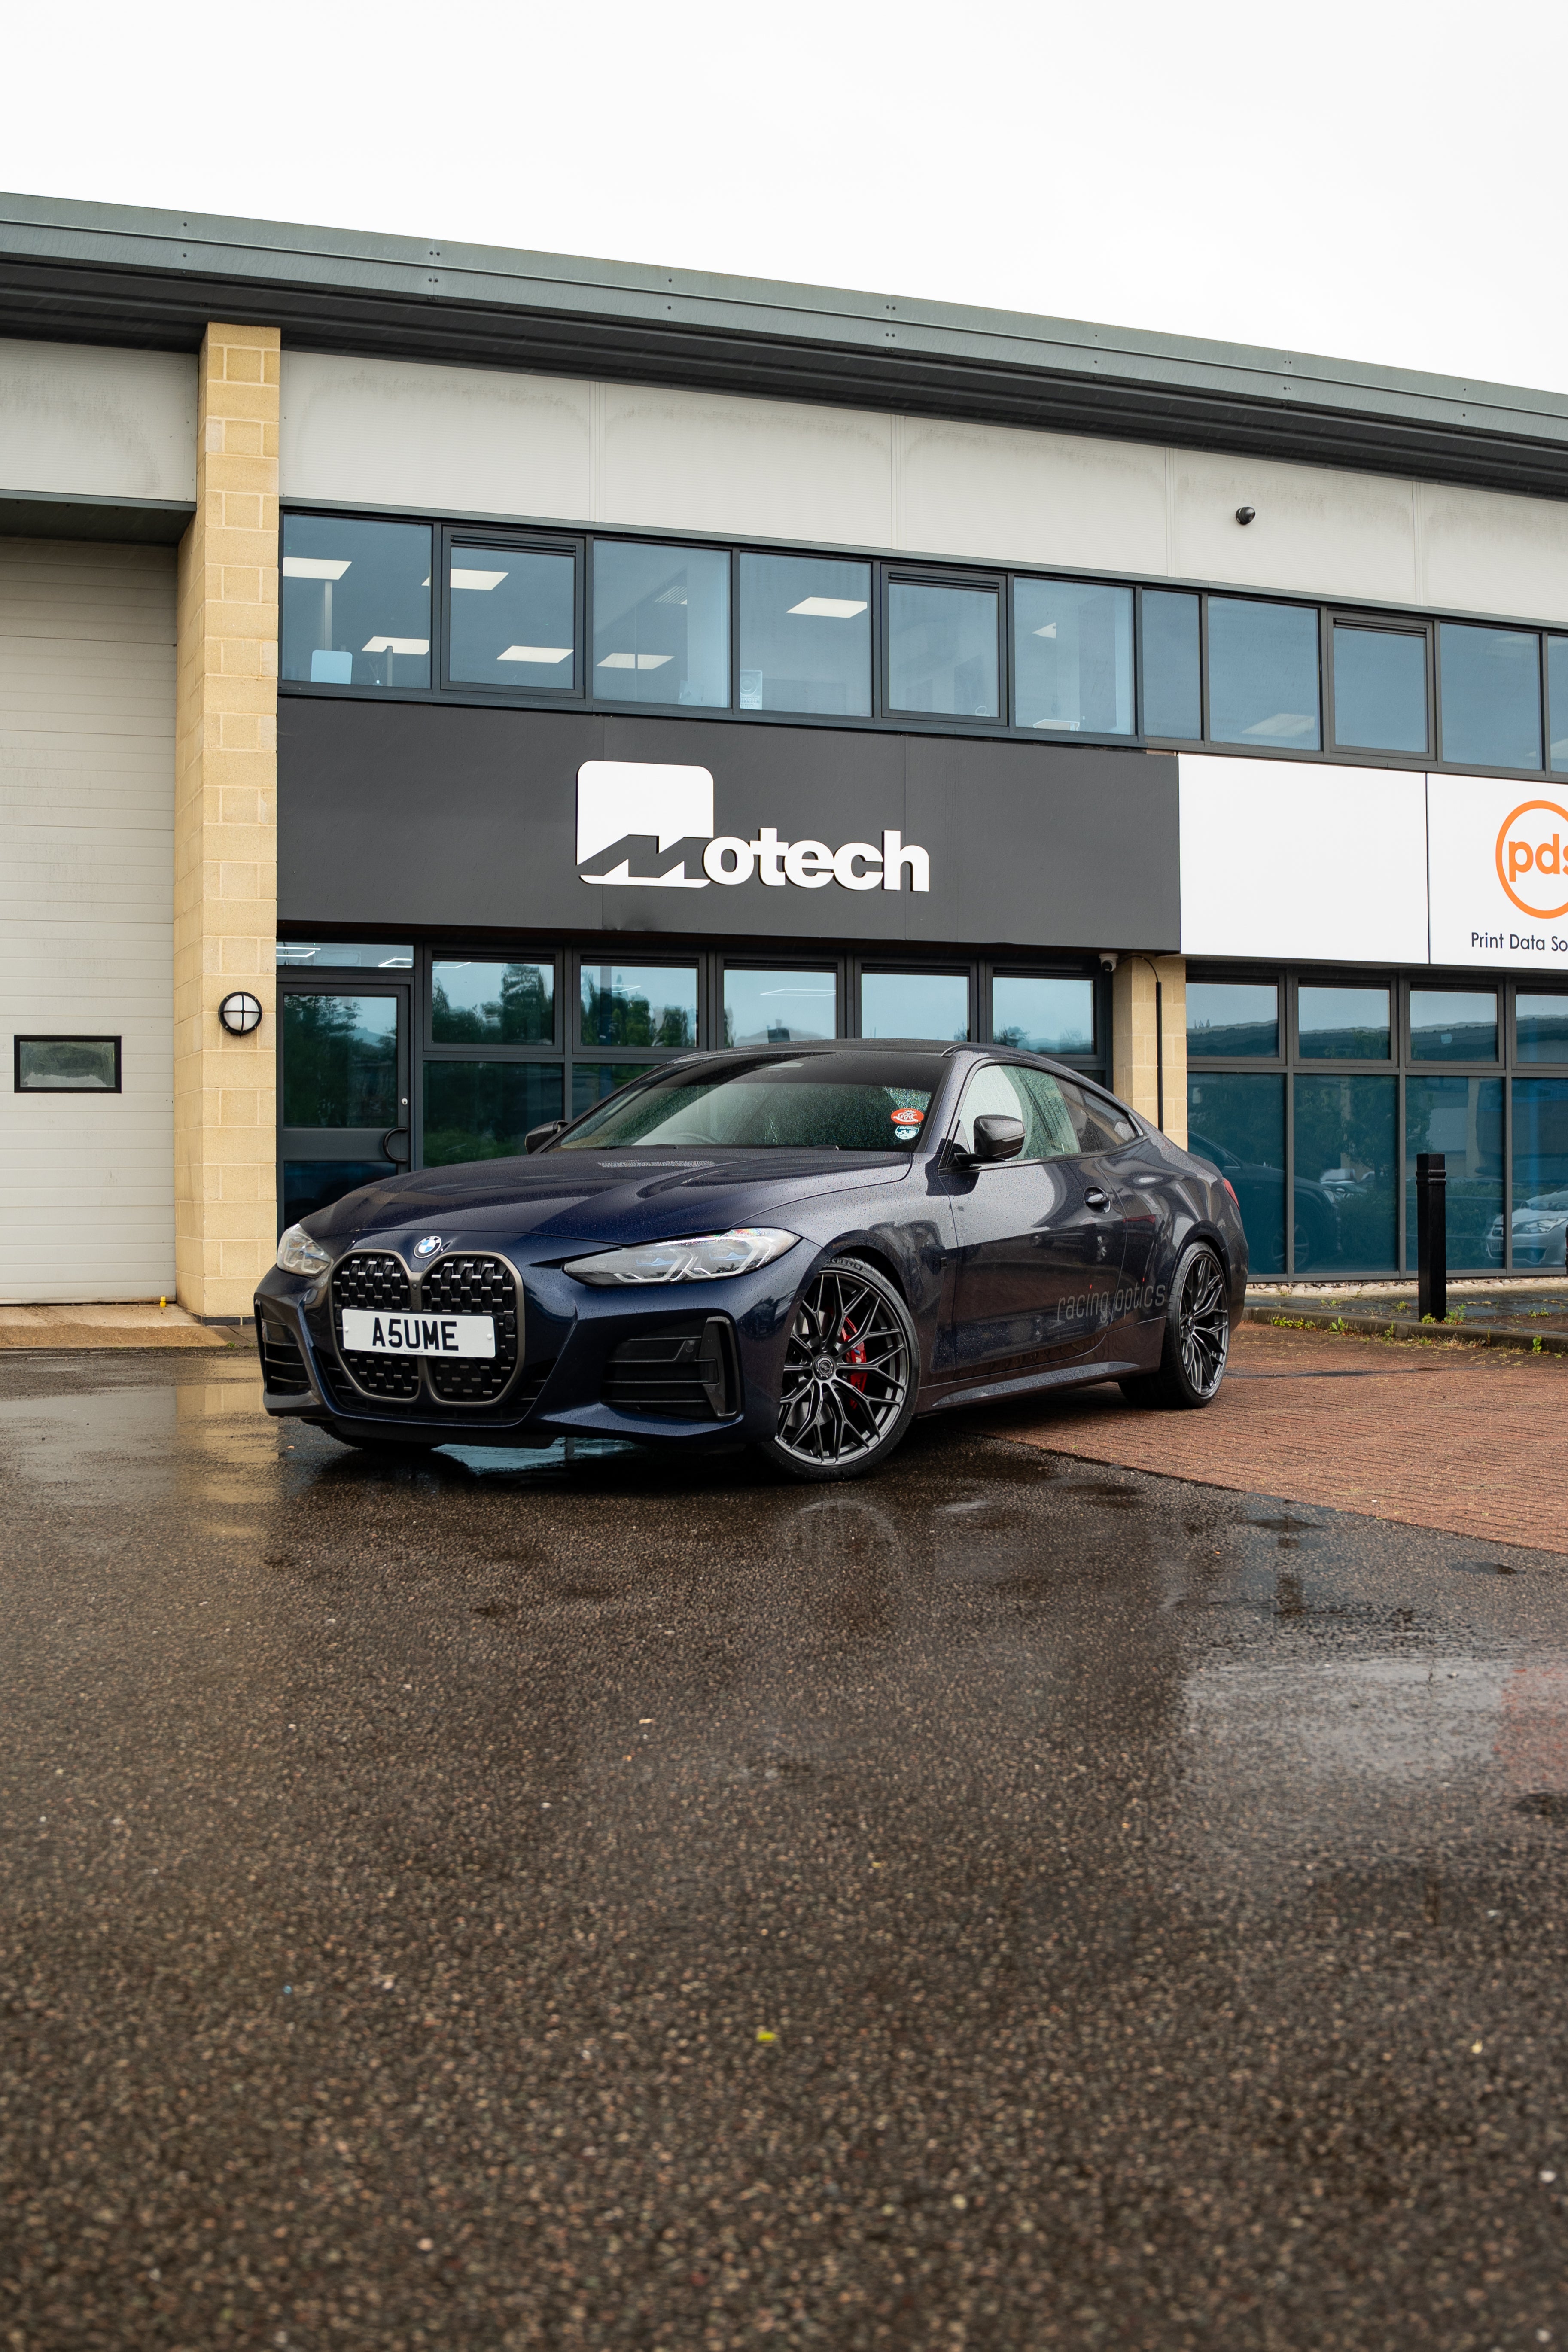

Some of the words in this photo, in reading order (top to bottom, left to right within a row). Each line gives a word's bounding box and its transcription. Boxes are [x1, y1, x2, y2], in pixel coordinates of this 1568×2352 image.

[576, 760, 929, 892] Motech
[1471, 932, 1504, 948] Print
[1510, 934, 1545, 950] Data
[1552, 936, 1568, 951] So
[1057, 1284, 1109, 1324] racing
[1115, 1278, 1166, 1319] optics
[372, 1317, 459, 1351] A5UME
